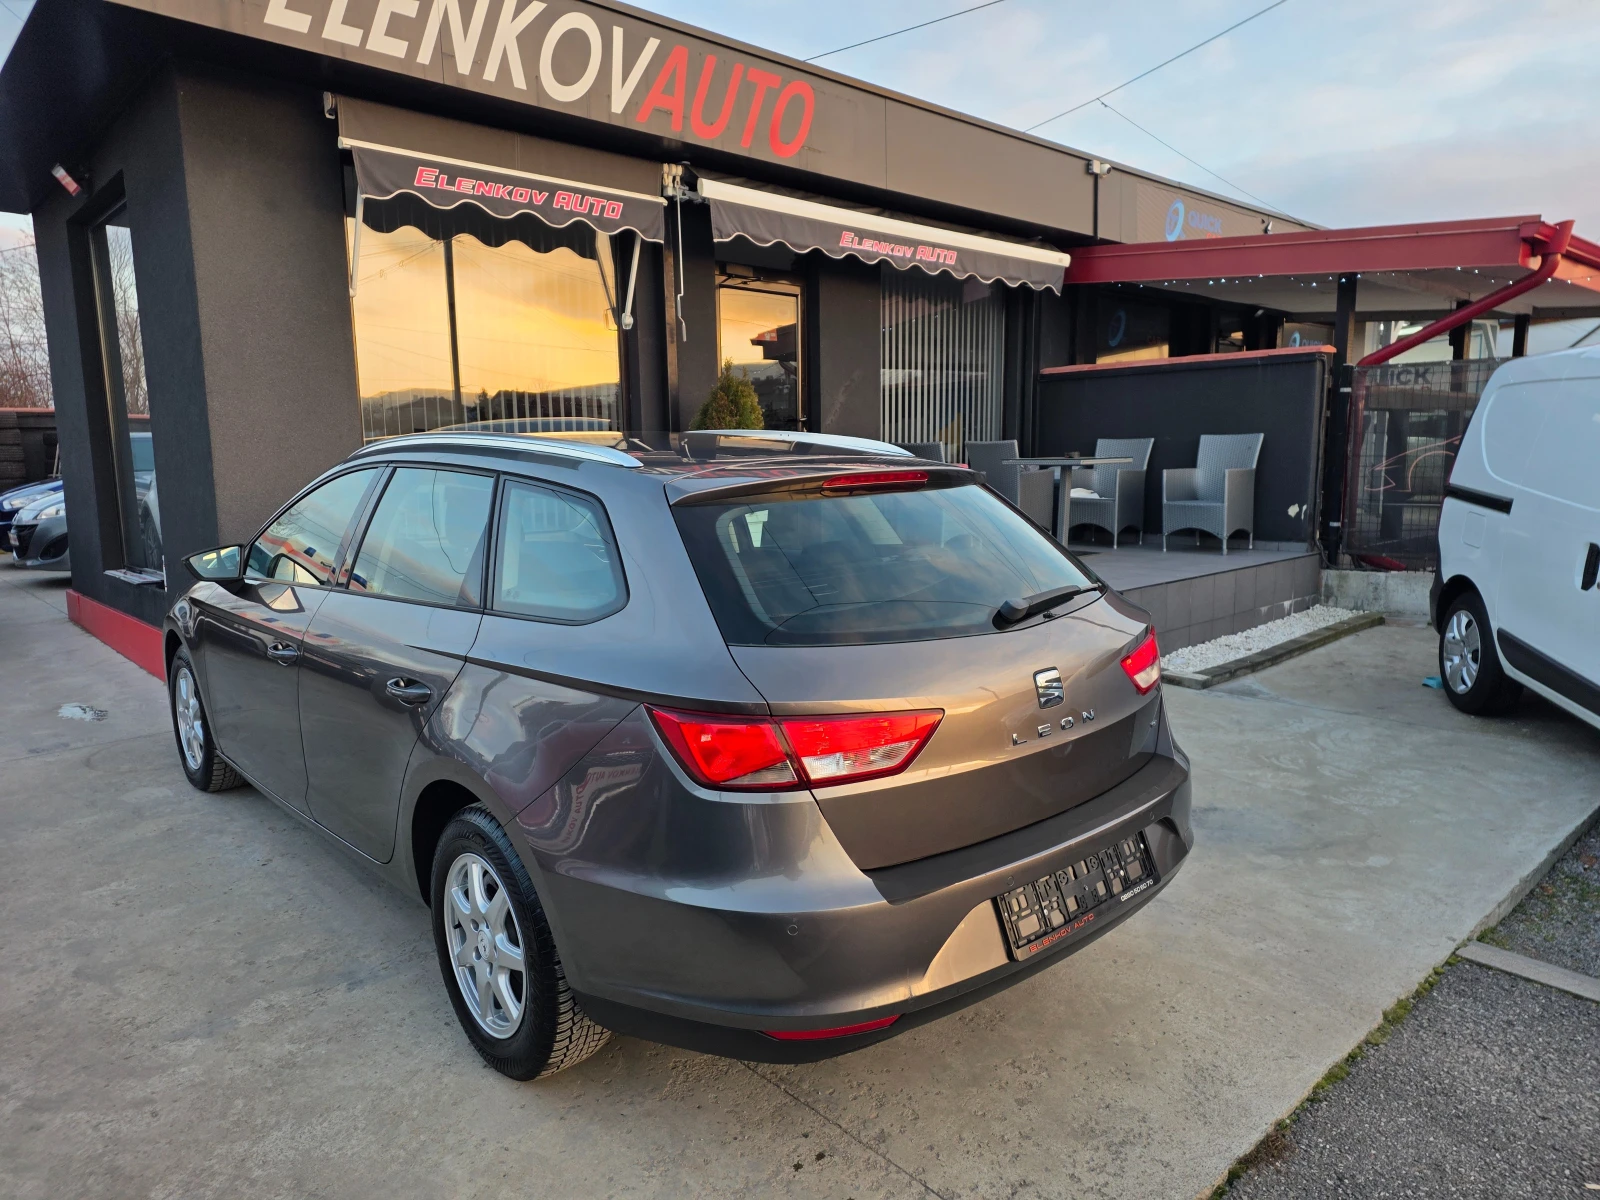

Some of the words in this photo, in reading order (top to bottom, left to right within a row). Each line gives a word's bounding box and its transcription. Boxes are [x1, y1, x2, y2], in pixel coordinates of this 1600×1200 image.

[414, 166, 549, 205] ELENKOV
[553, 191, 623, 219] AUTO
[839, 231, 914, 258] ELENKOV
[916, 245, 957, 265] AUTO
[1012, 709, 1095, 746] LEON
[1074, 913, 1095, 929] AUTO
